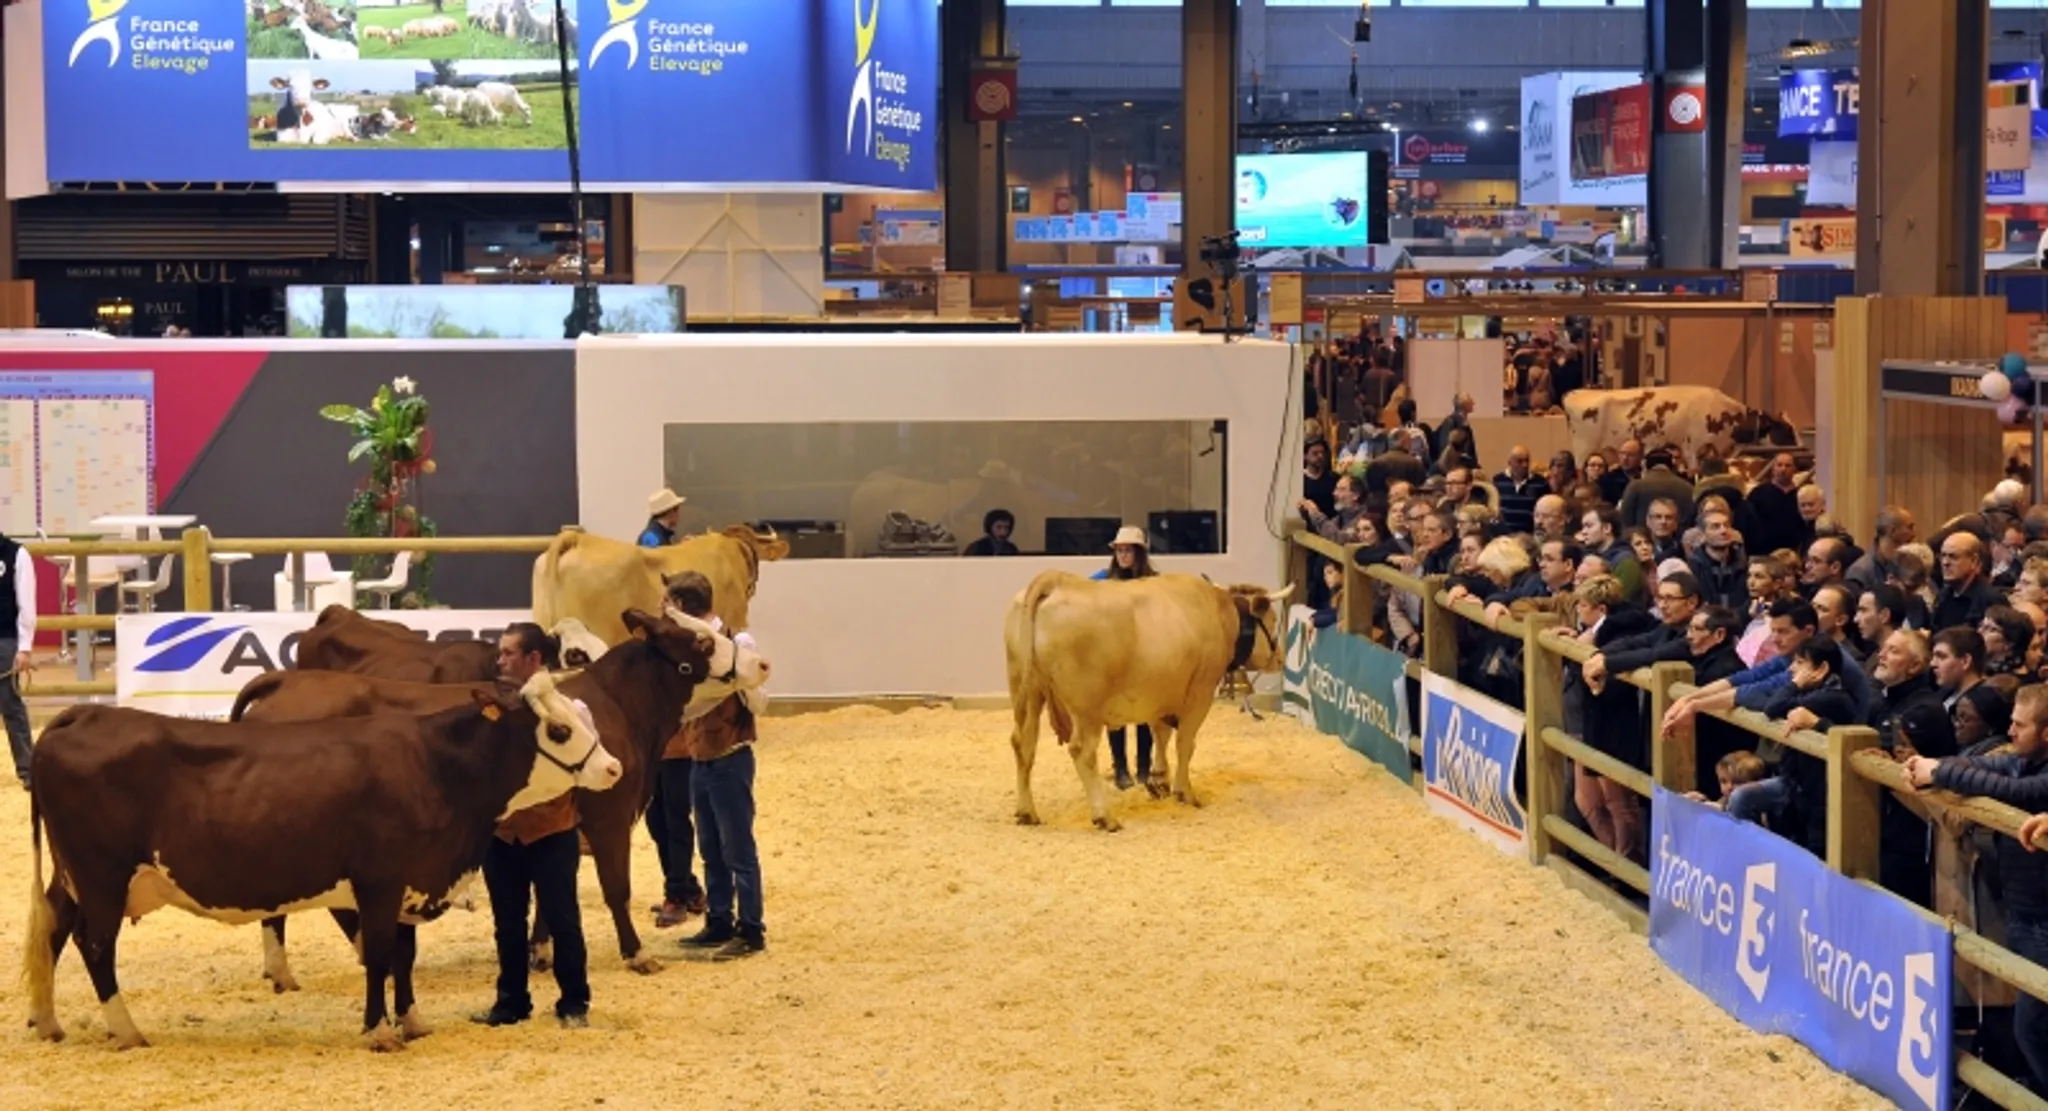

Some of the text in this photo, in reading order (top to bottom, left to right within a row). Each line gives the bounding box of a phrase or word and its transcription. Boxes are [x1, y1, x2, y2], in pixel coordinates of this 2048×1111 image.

[130, 15, 200, 32] France
[648, 18, 715, 36] France
[130, 33, 235, 55] Génétique
[648, 36, 749, 57] Génétique
[875, 60, 908, 94] France
[875, 96, 922, 137] Génétique
[155, 261, 237, 283] PAUL
[144, 302, 186, 315] PAUL
[1655, 833, 1736, 936] france
[1799, 908, 1895, 1033] france
